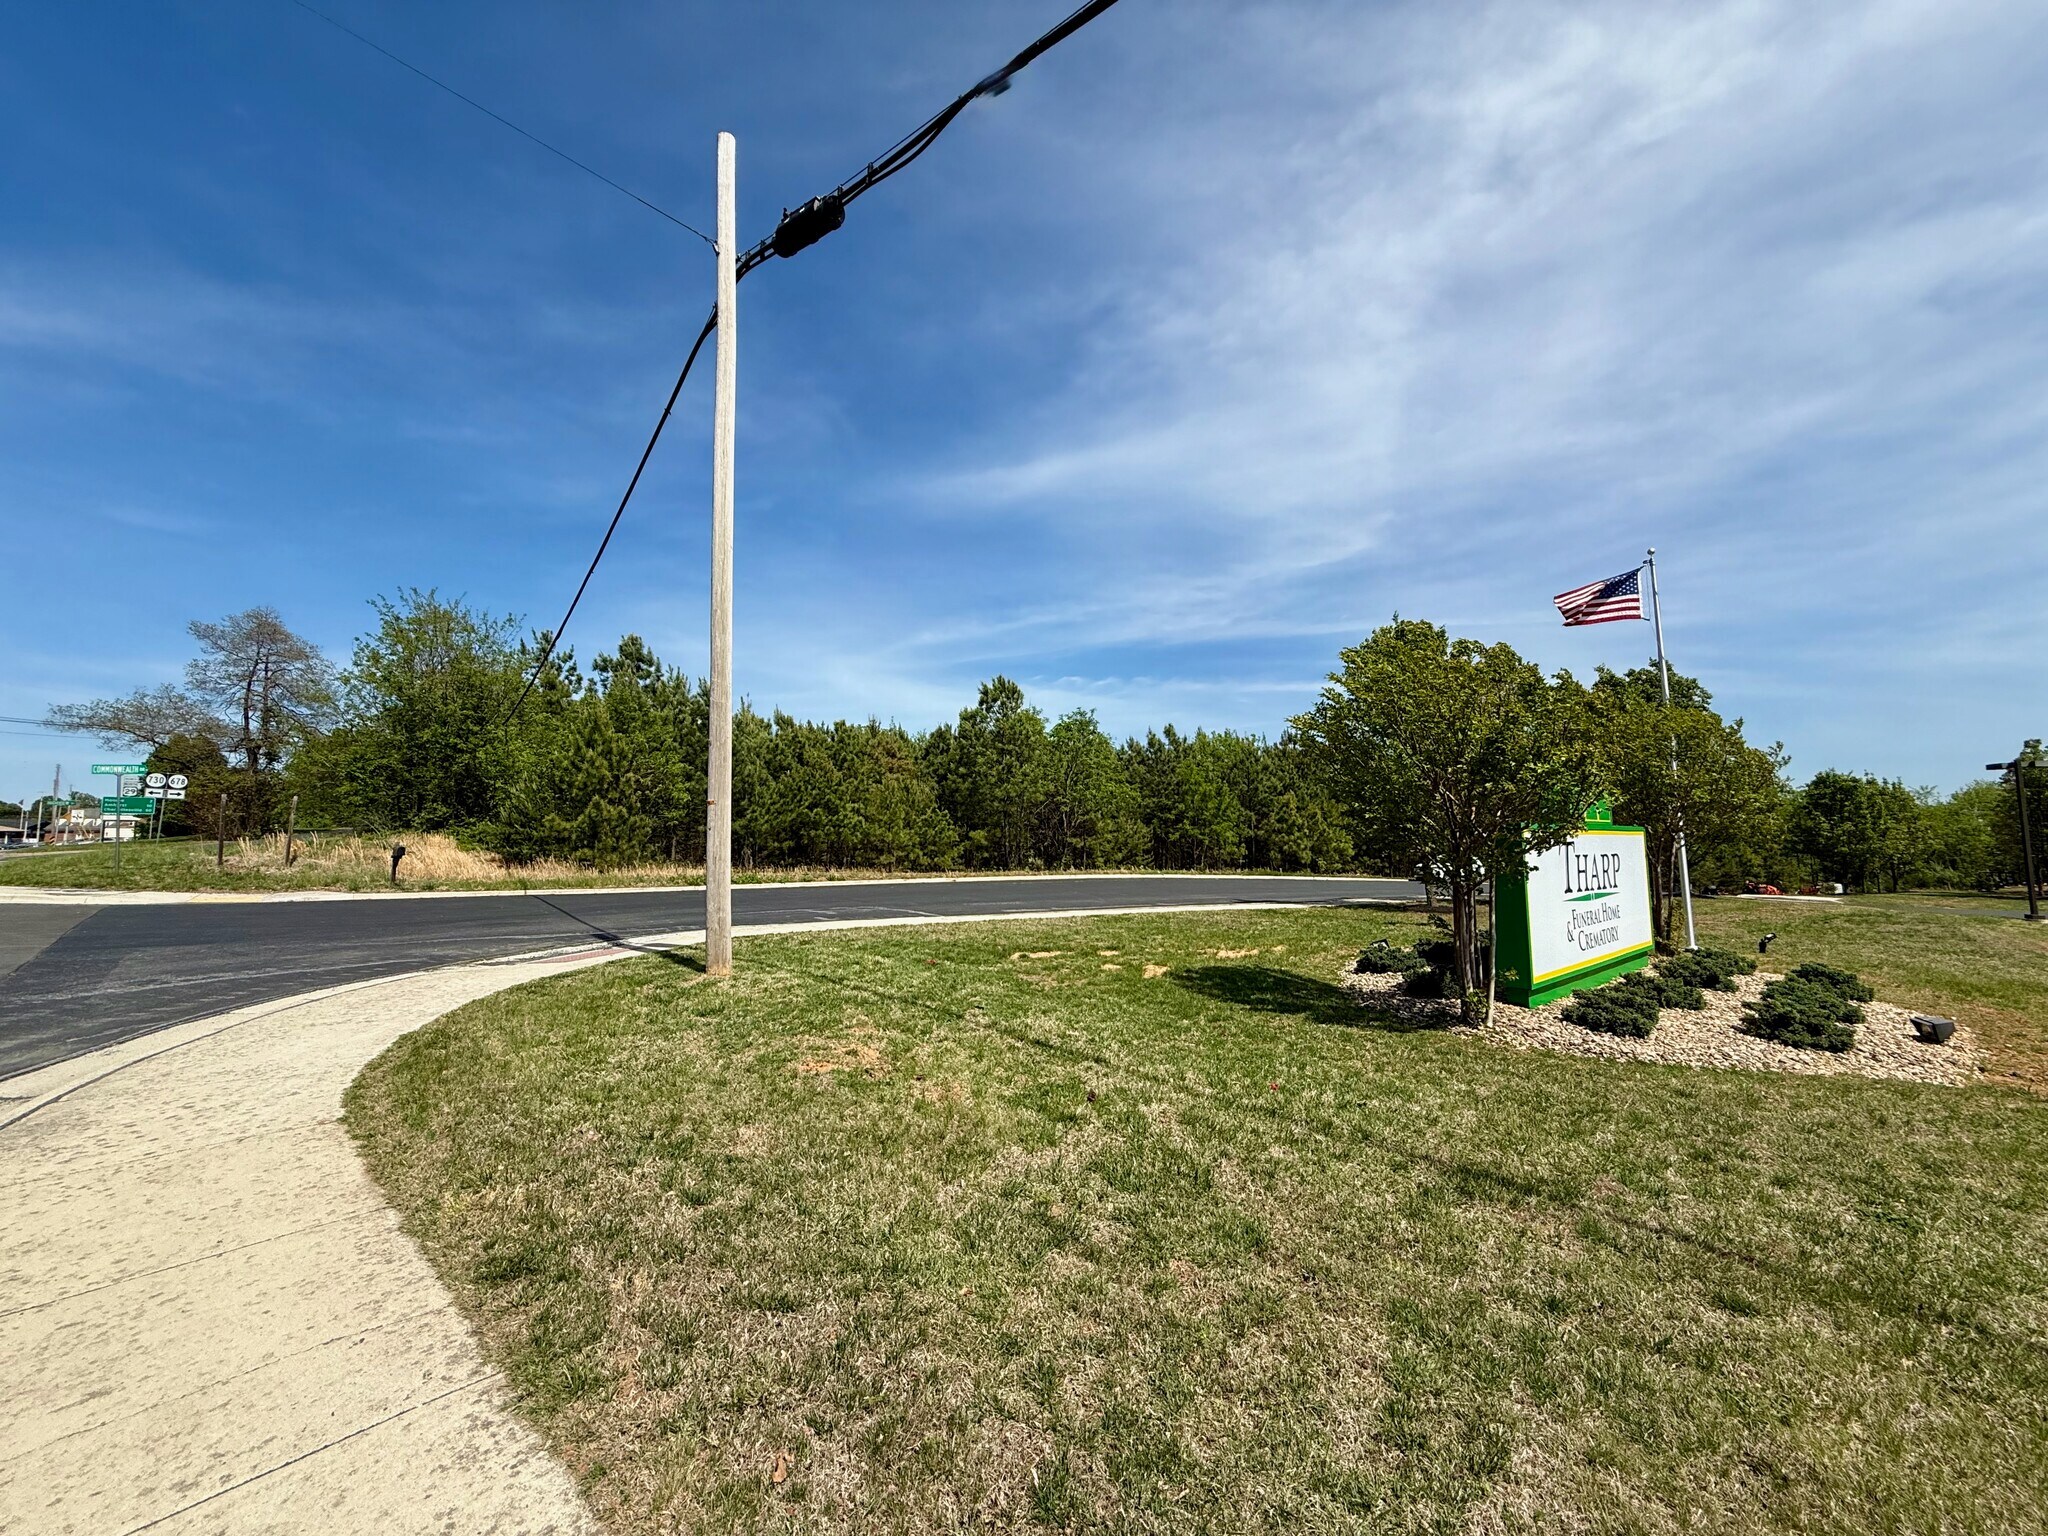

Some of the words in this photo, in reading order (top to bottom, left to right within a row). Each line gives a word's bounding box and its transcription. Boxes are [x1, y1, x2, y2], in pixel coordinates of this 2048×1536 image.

[93, 765, 139, 773] COMMONWEALTH
[148, 776, 165, 784] 730
[1559, 841, 1621, 894] THARP
[1572, 909, 1602, 930] FUNERAL
[1601, 903, 1621, 923] HOME
[1567, 921, 1575, 943] &
[1578, 926, 1619, 952] CREMATORY
